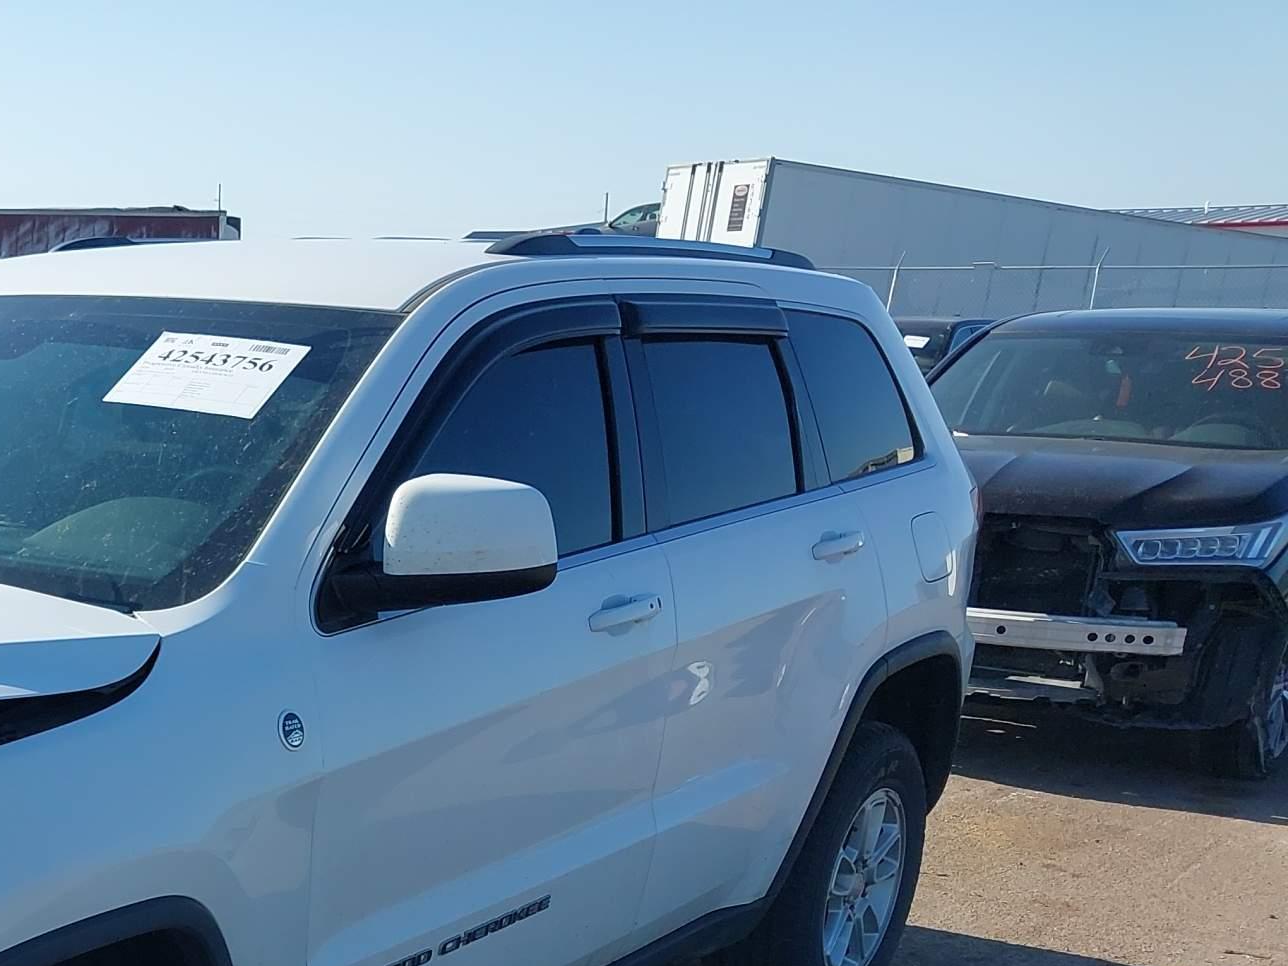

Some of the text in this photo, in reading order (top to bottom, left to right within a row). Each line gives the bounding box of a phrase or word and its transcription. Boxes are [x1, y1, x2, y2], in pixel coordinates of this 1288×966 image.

[158, 349, 278, 373] 42543756
[1185, 345, 1285, 369] 425
[1191, 368, 1281, 391] 488
[438, 894, 552, 956] CHEROKEE
